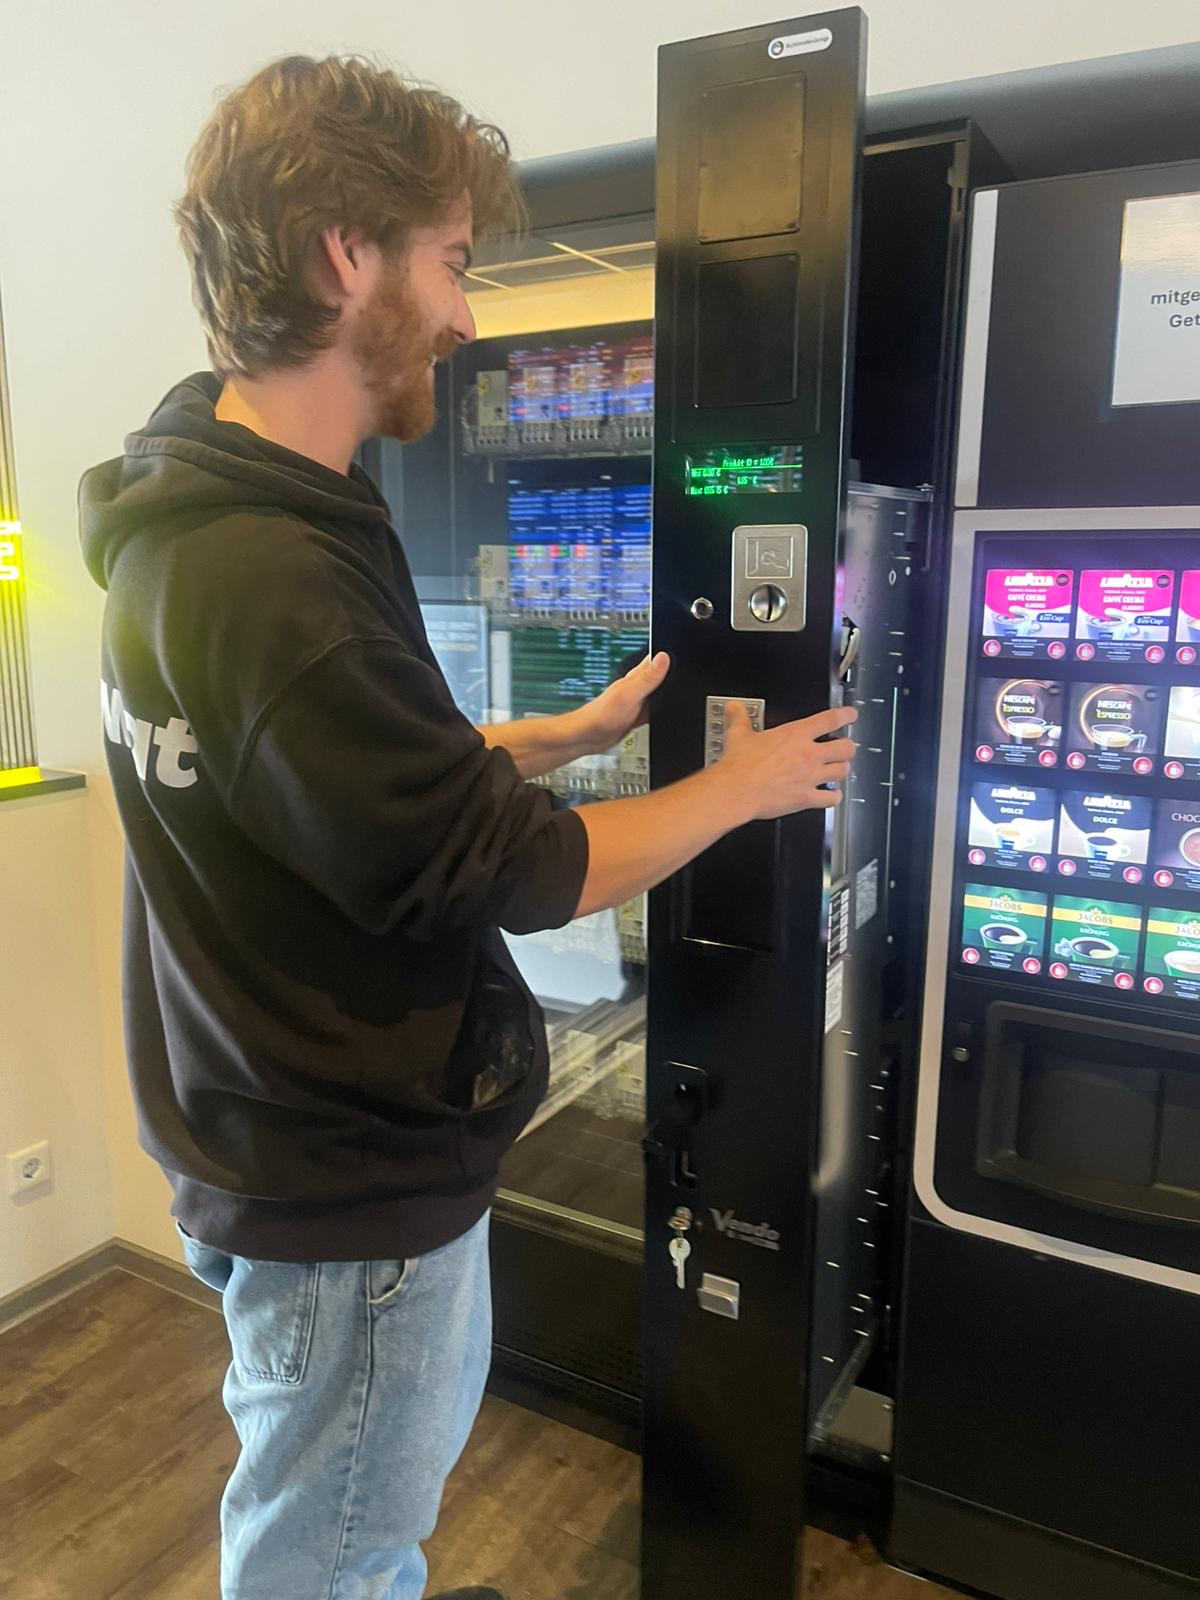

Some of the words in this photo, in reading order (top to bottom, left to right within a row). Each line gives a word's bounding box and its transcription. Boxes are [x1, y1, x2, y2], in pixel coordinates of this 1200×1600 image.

[1151, 290, 1200, 306] mitge
[1169, 313, 1200, 328] Get
[1000, 807, 1024, 815] DOLCE
[1093, 816, 1118, 824] DOLCE
[1171, 813, 1200, 823] CHOC
[989, 900, 1023, 911] JACOBS
[1079, 912, 1113, 924] JACOBS
